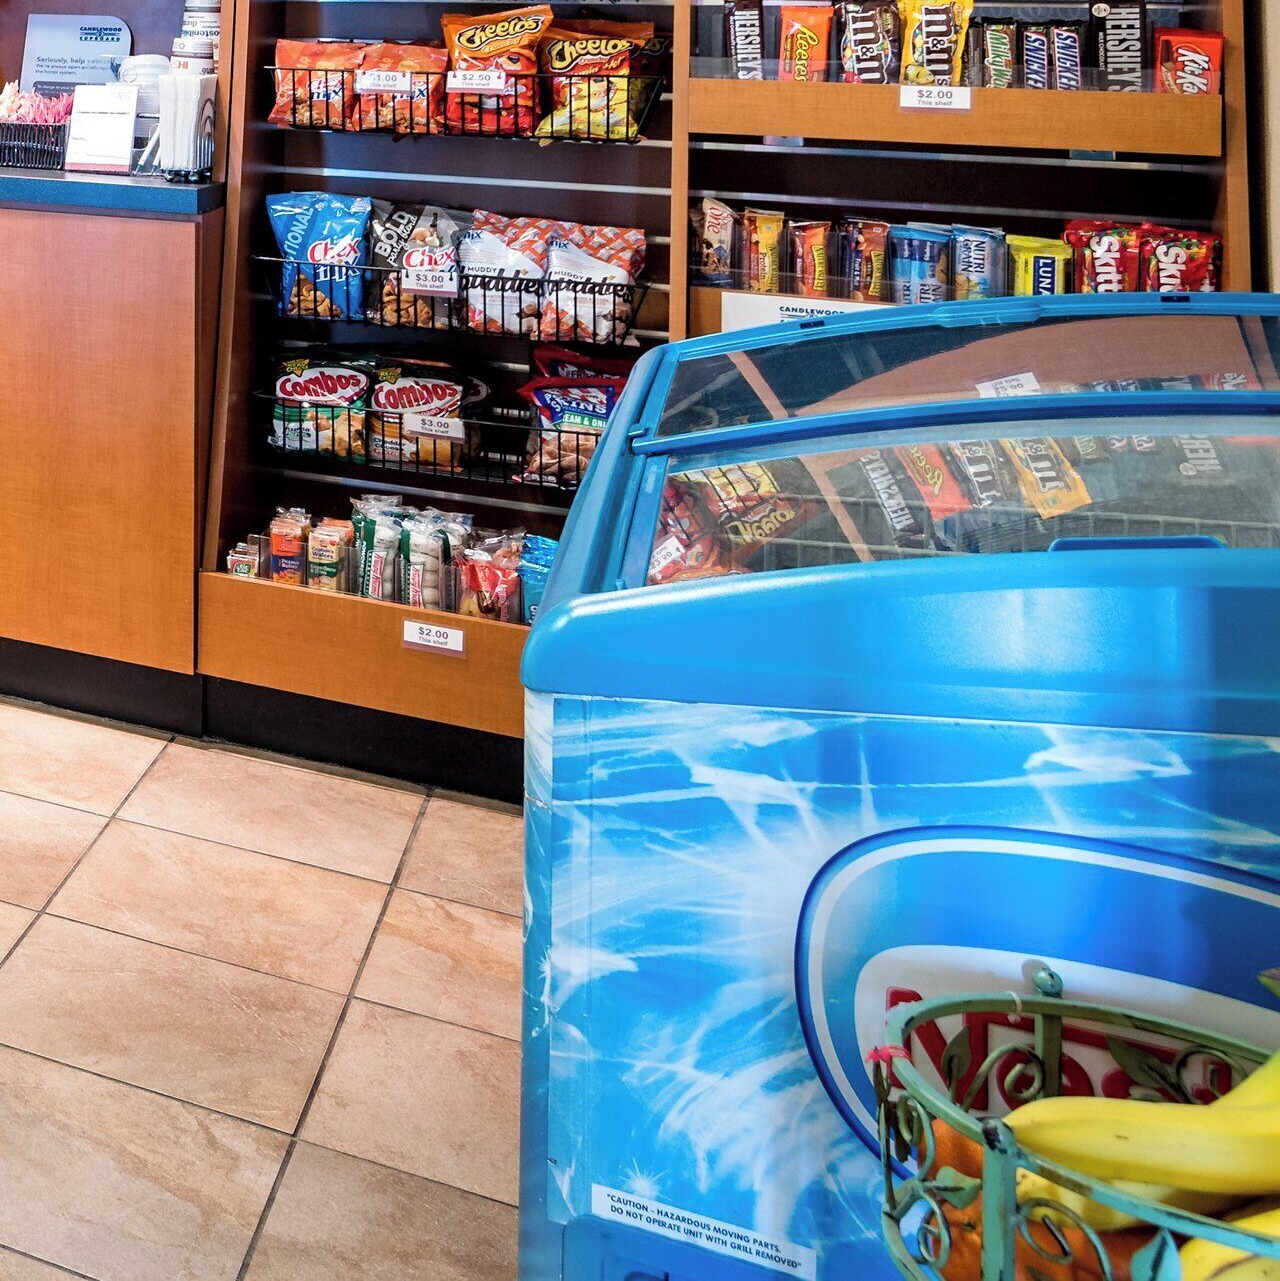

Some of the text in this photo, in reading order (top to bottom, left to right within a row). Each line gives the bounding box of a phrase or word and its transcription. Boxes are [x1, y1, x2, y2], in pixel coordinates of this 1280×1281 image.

[457, 15, 543, 50] Cheetos
[734, 10, 764, 80] HERSHEY'S
[549, 39, 634, 72] Cheetos
[985, 31, 1010, 63] Milky
[36, 56, 86, 64] Seriously, help
[462, 74, 491, 82] $2.50
[917, 91, 953, 99] $2.00
[375, 210, 411, 256] BOLD
[387, 215, 418, 267] party blend
[403, 245, 456, 269] Chex
[973, 239, 985, 274] NUTRI
[415, 273, 444, 283] $3.00
[554, 270, 584, 281] MUDDY
[279, 372, 361, 396] Combos
[374, 381, 458, 408] Combos
[551, 398, 606, 414] SKINS
[421, 419, 449, 429] $3.00
[418, 626, 449, 640] $2.00
[607, 1194, 781, 1253] "CAUTION HAZARDOUS MOVING PARTS.
[610, 1205, 801, 1269] DO NOT OPERATE UNIT WITH GRILL REMOVED"
